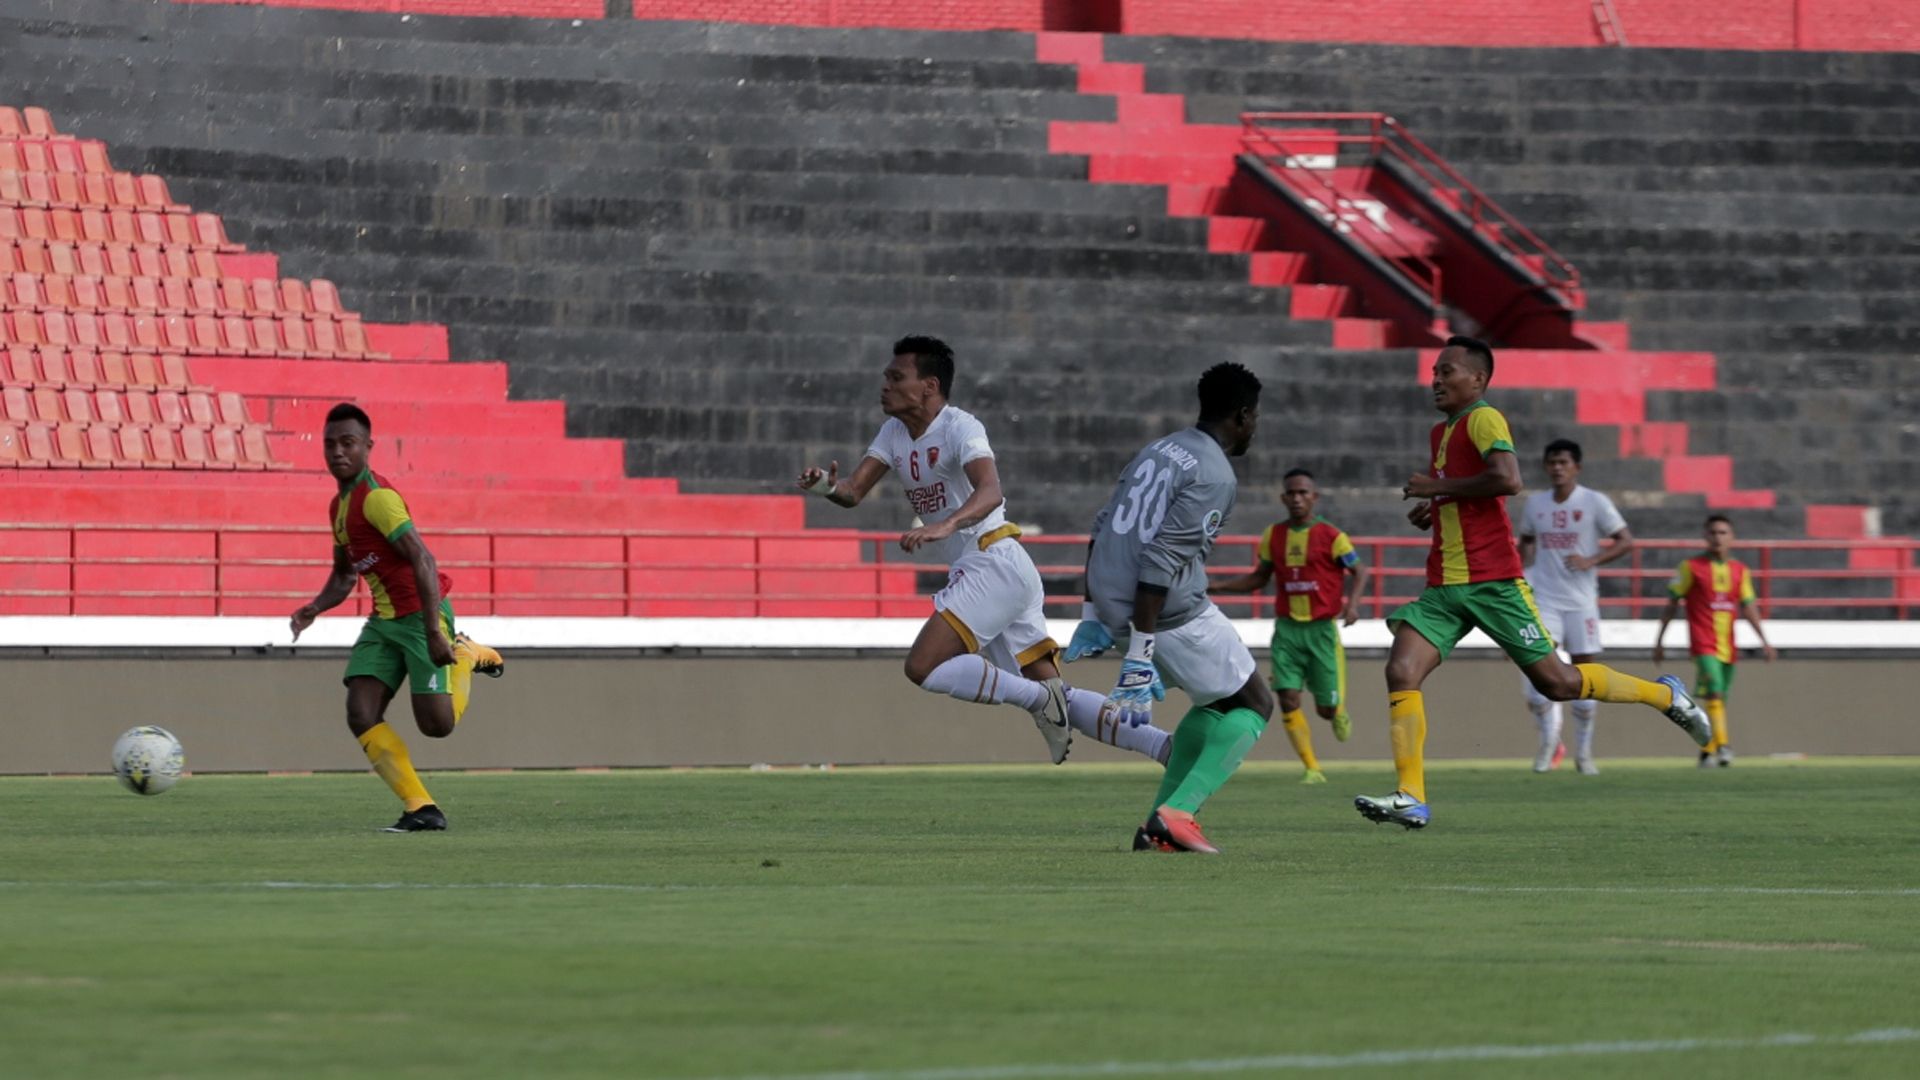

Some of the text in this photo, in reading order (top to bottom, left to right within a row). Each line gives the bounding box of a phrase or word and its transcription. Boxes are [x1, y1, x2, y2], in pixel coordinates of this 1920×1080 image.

[910, 450, 920, 482] 6
[910, 495, 947, 515] EMEN
[1112, 458, 1171, 544] 30
[1519, 623, 1540, 646] 20
[428, 672, 438, 691] 4
